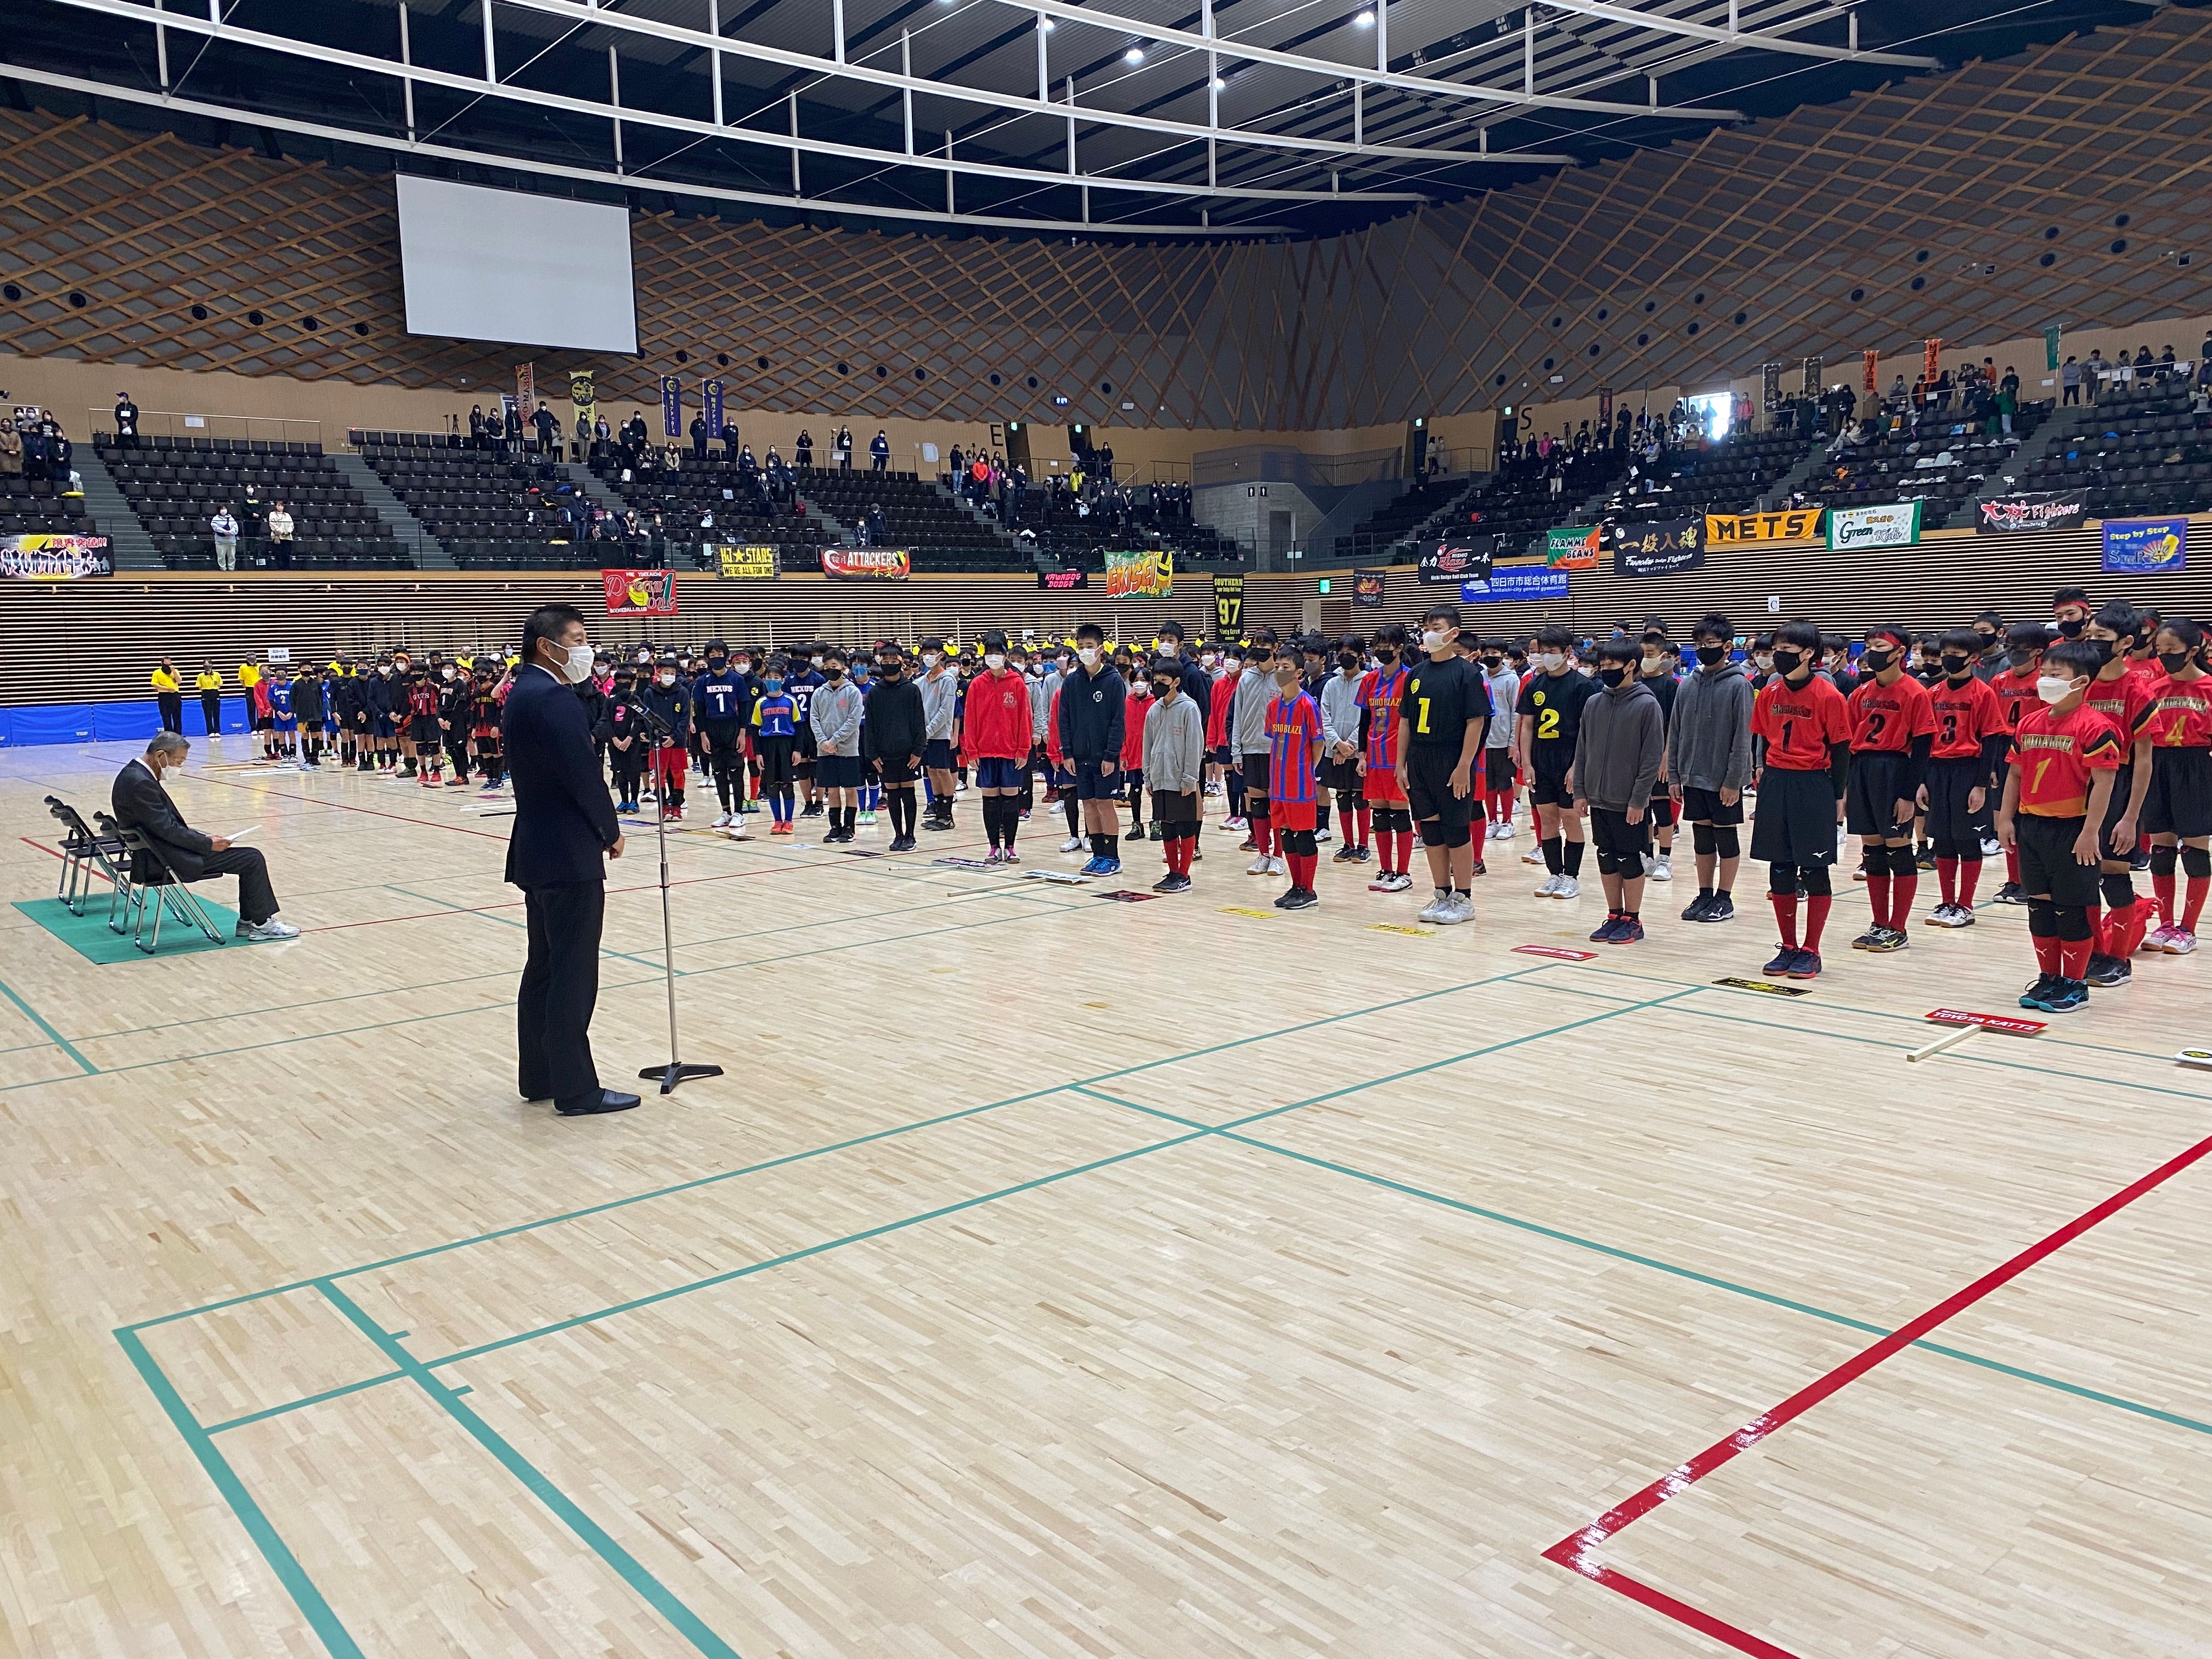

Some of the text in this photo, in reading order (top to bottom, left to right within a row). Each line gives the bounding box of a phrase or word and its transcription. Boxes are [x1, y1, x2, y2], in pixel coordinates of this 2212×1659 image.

[1520, 407, 1532, 430] S
[990, 424, 1003, 447] E
[1717, 514, 1806, 539] METS
[1839, 521, 1872, 544] Green
[2147, 526, 2170, 535] Step
[1550, 537, 1587, 549] FLAMME
[745, 548, 773, 563] STARS
[848, 552, 898, 567] ATTACKERS
[1471, 552, 1491, 563] 一本
[1566, 546, 1595, 560] BEANS
[606, 574, 664, 597] Dream
[1491, 574, 1567, 587] 四日市市総合体育館
[1147, 585, 1160, 595] KIDS
[646, 596, 676, 610] one
[1770, 600, 1778, 610] C
[413, 692, 430, 701] GUTS
[707, 685, 733, 693] NEXUS
[791, 685, 814, 693] NEXUS
[419, 699, 422, 709] 1
[442, 695, 446, 706] 1
[716, 693, 724, 712] 1
[797, 693, 808, 712] 2
[614, 706, 626, 721] 2
[1417, 698, 1431, 733] 1
[2008, 700, 2021, 727] 4
[772, 718, 781, 733] 1
[1537, 708, 1560, 738] 2
[1866, 713, 1886, 744] 2
[1940, 715, 1957, 744] 3
[2165, 715, 2187, 746] 4
[1782, 720, 1793, 752] 1
[2031, 758, 2052, 793] 1
[1934, 1012, 1986, 1023] TOYOTA
[1986, 1019, 2039, 1030] KATTZ
